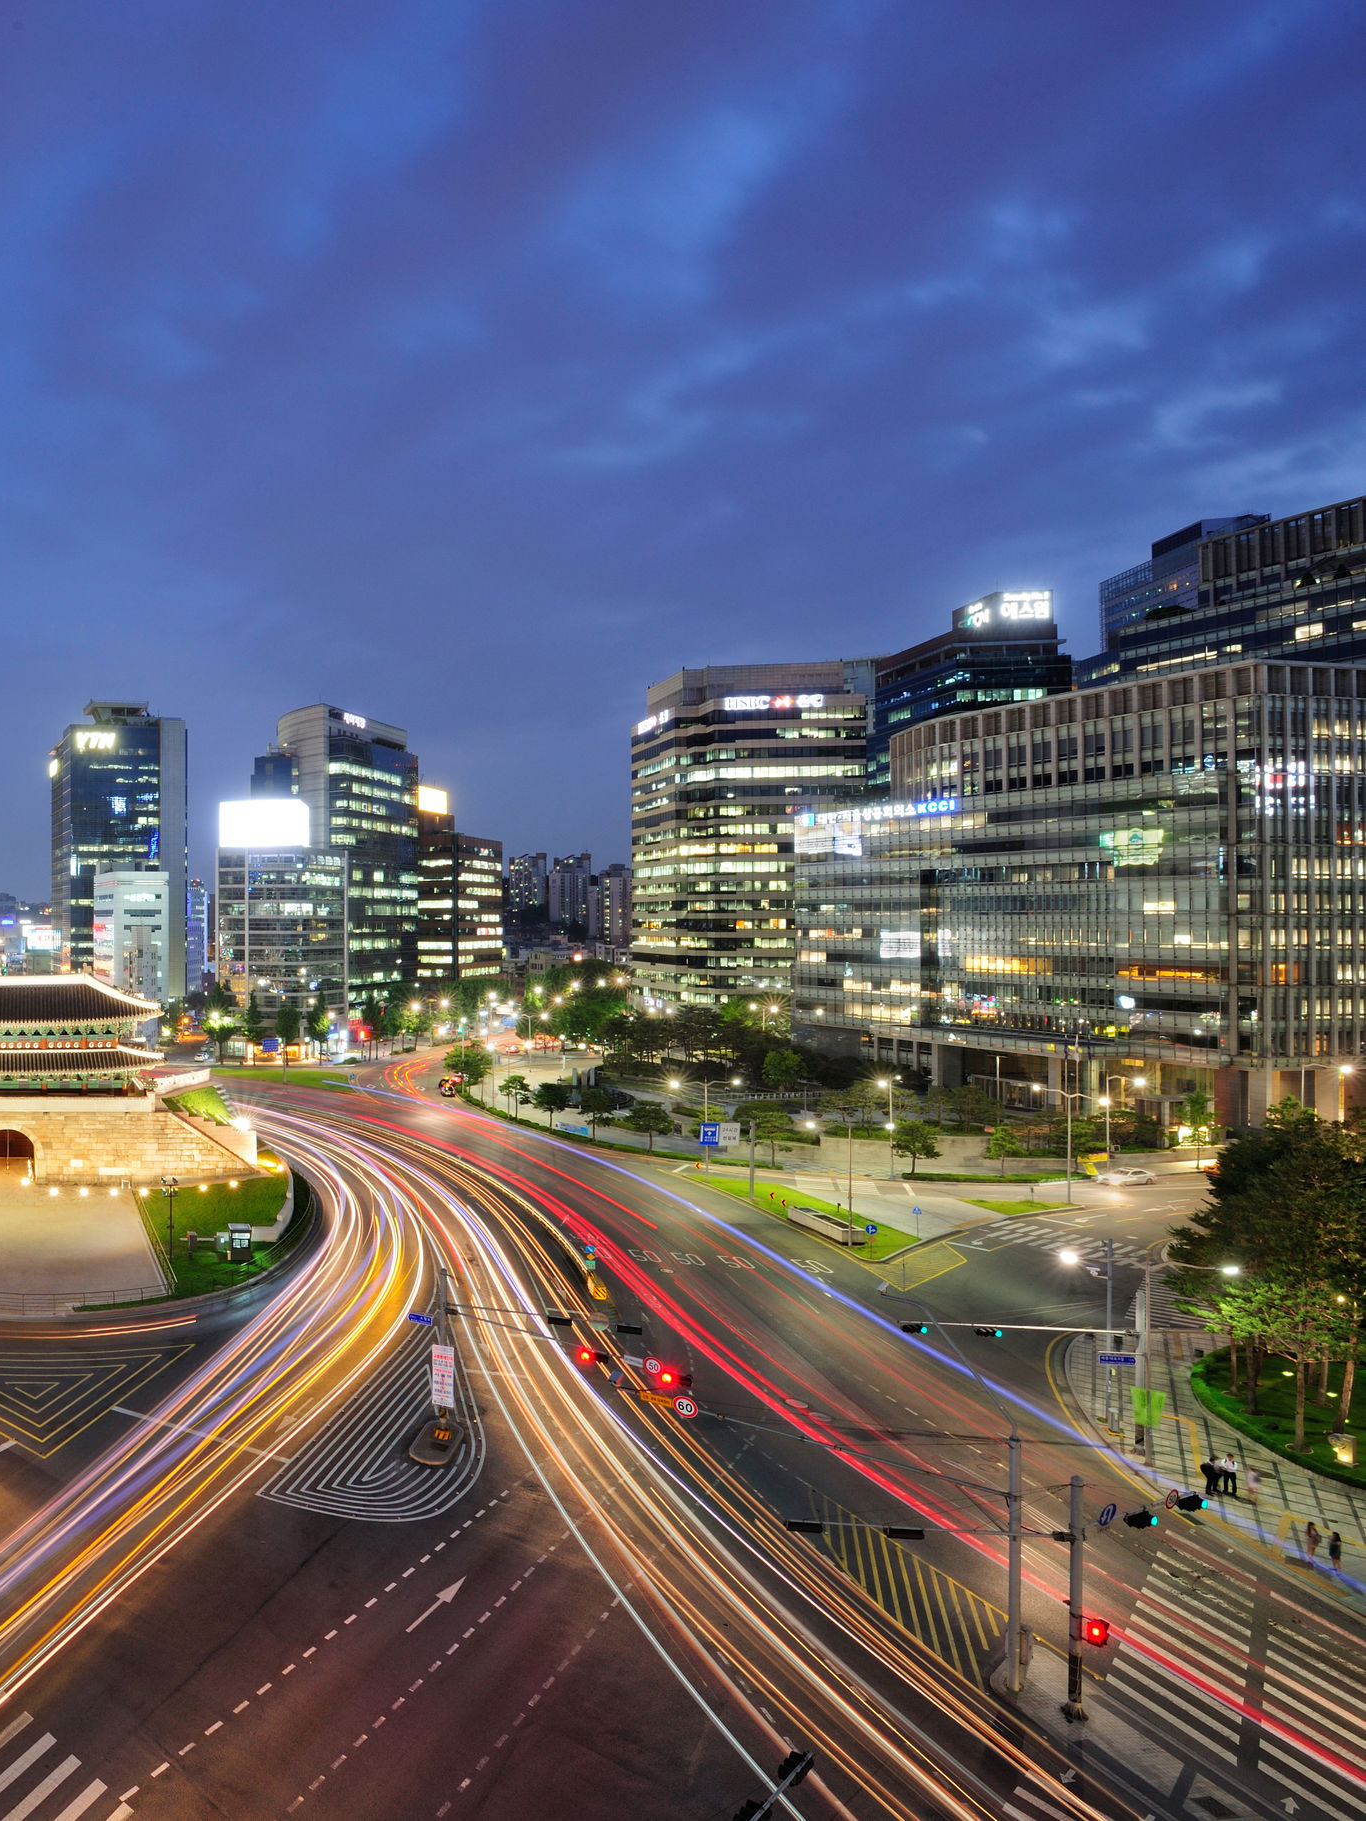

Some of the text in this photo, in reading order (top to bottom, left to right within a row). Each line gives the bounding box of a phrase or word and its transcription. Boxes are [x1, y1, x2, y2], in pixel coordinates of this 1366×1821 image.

[1001, 601, 1050, 620] 에스원
[724, 695, 771, 711] HSBC
[75, 731, 116, 749] YTN
[917, 799, 956, 814] KCCI
[628, 1249, 662, 1263] 50
[670, 1252, 706, 1266] 50
[717, 1254, 756, 1270] 50
[790, 1258, 834, 1274] 50
[648, 1362, 661, 1372] 50
[677, 1401, 693, 1413] 60
